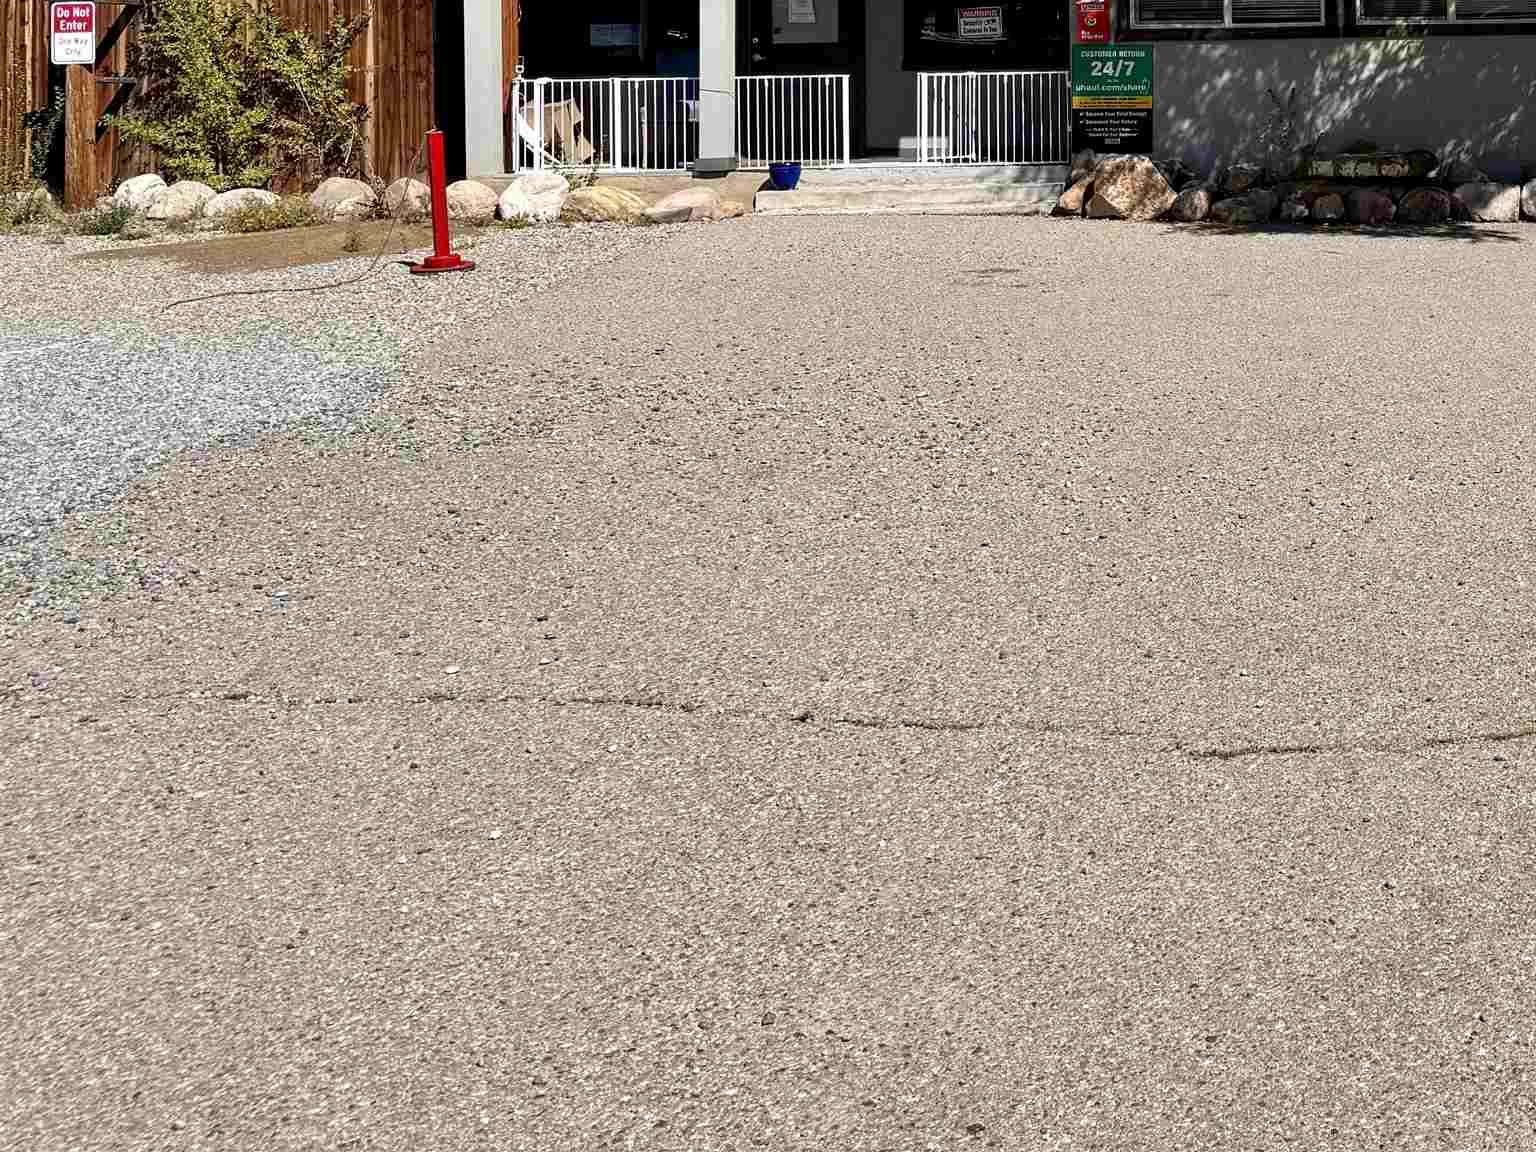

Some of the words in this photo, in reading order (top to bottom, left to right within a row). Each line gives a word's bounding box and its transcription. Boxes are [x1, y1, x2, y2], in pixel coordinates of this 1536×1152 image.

[57, 8, 70, 17] Do
[73, 7, 90, 17] Not
[60, 19, 87, 31] Enter
[1090, 59, 1136, 77] 24/7
